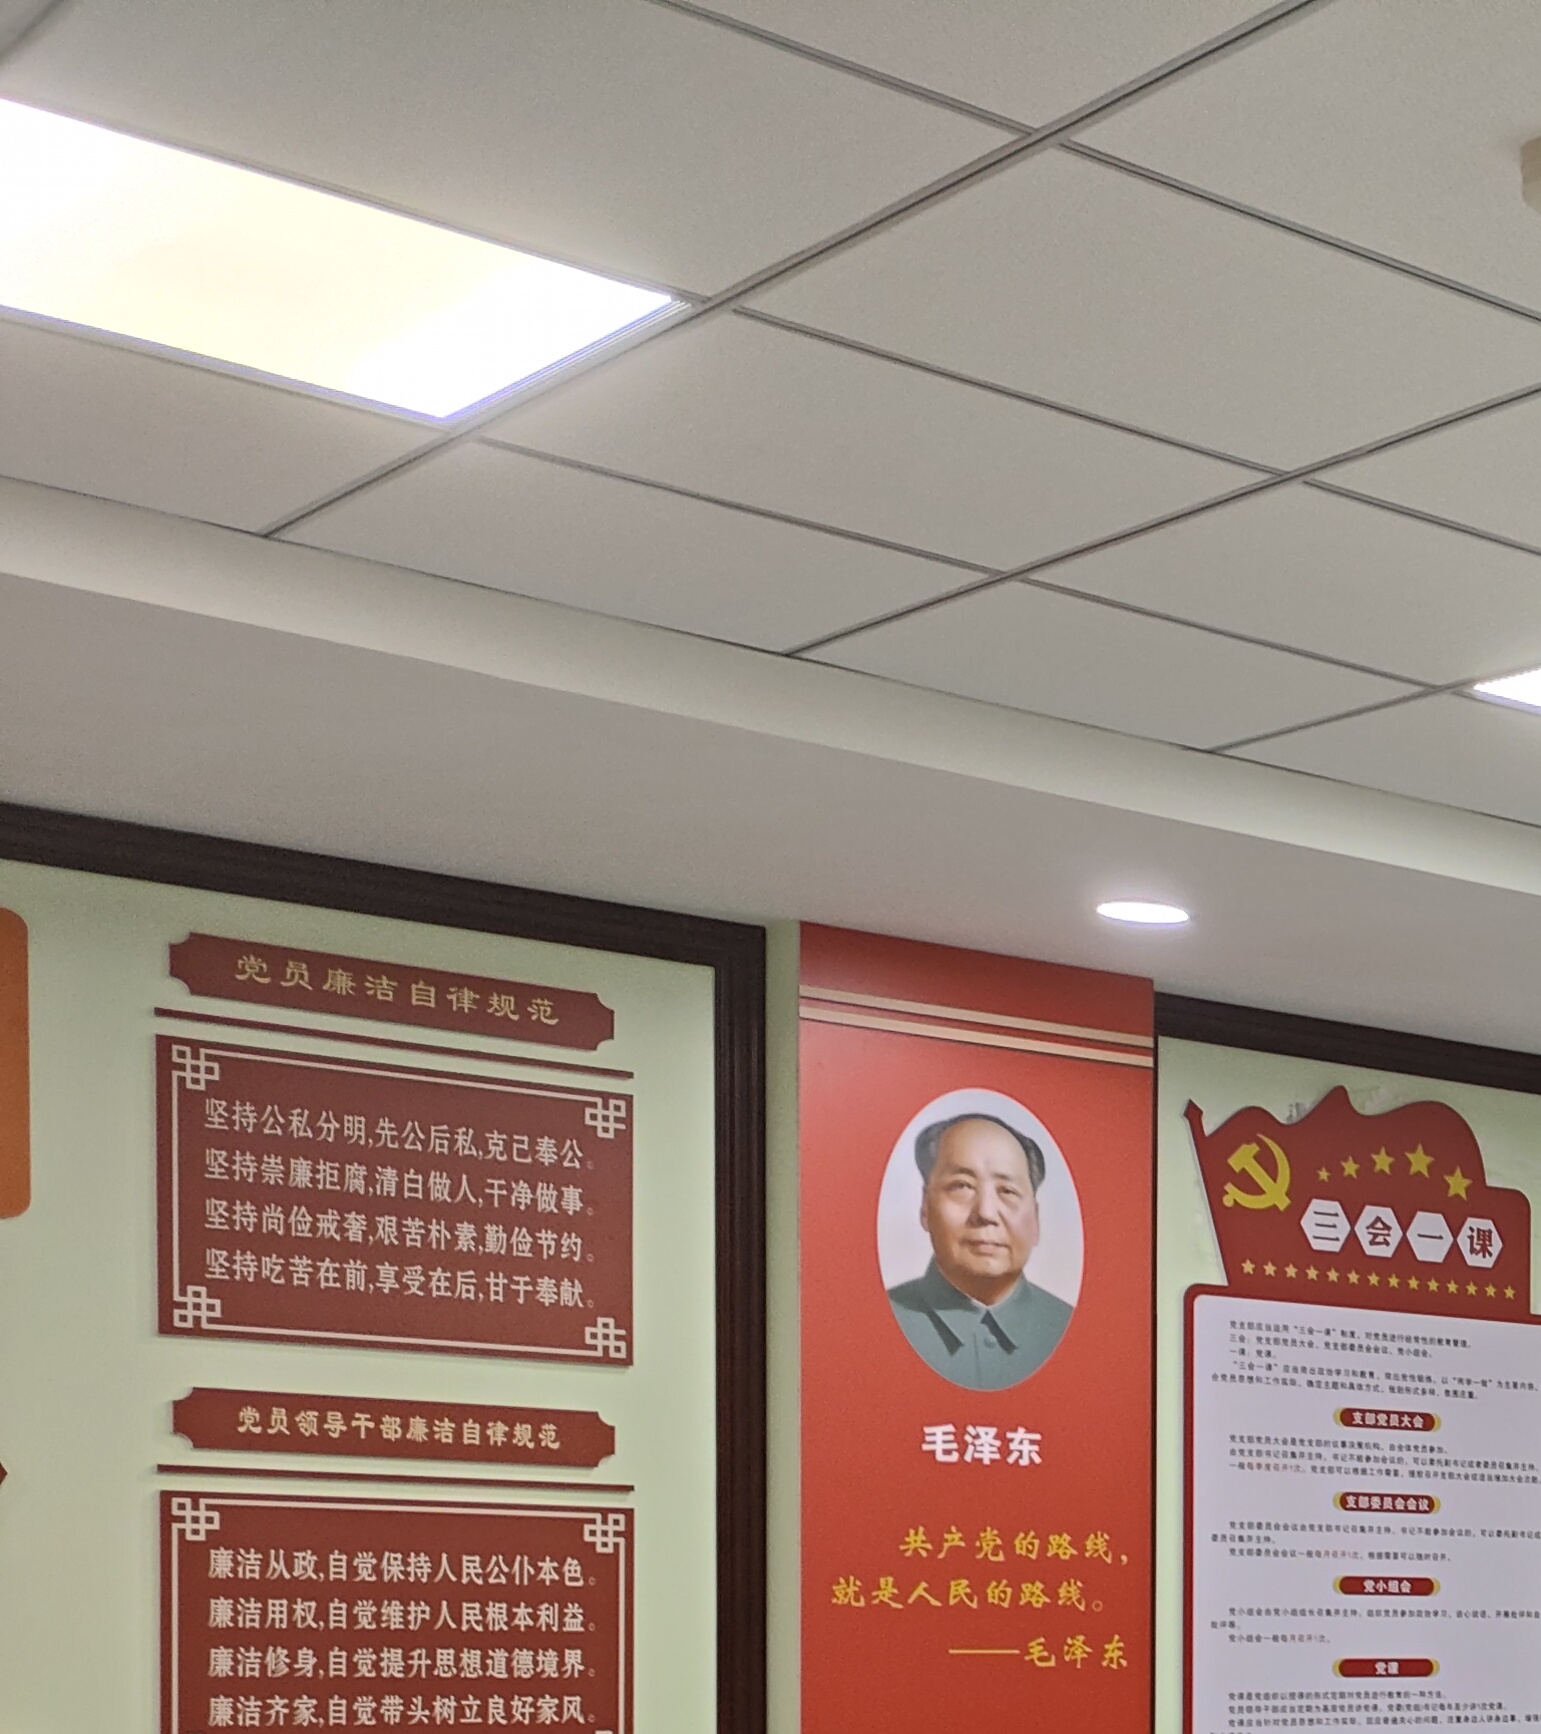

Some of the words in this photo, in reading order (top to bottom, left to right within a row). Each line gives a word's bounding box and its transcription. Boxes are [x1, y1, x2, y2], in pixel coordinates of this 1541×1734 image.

[235, 954, 559, 1026] 党员廉洁自律规范
[205, 1099, 595, 1170] 坚持公私分明，先公后私，克己奉公。
[205, 1148, 595, 1215] 坚持崇廉拒腐，清白做人，干净做事。
[205, 1199, 595, 1262] 坚持尚俭戒奢，艰苦朴素，勤俭节约。
[1312, 1210, 1494, 1259] 三会一课
[205, 1248, 595, 1308] 坚持吃苦在前，享受在后，甘于奉献。
[236, 1408, 560, 1450] 党员领导干部廉洁自律规范
[922, 1423, 1042, 1468] 毛泽东
[899, 1525, 1130, 1566] 共产党的路线，
[209, 1547, 596, 1587] 廉洁从政，自觉保持人民公仆本色。
[1364, 1580, 1411, 1593] 党小组会
[831, 1576, 1104, 1612] 就是人民的路线。
[209, 1597, 596, 1633] 廉洁用权，自觉维护人民根本利益。
[209, 1646, 596, 1679] 廉洁修身，自觉提升思想道德境界。
[1375, 1662, 1399, 1675] 党课
[209, 1695, 596, 1728] 廉洁齐家，自觉带头树立良好家风。
